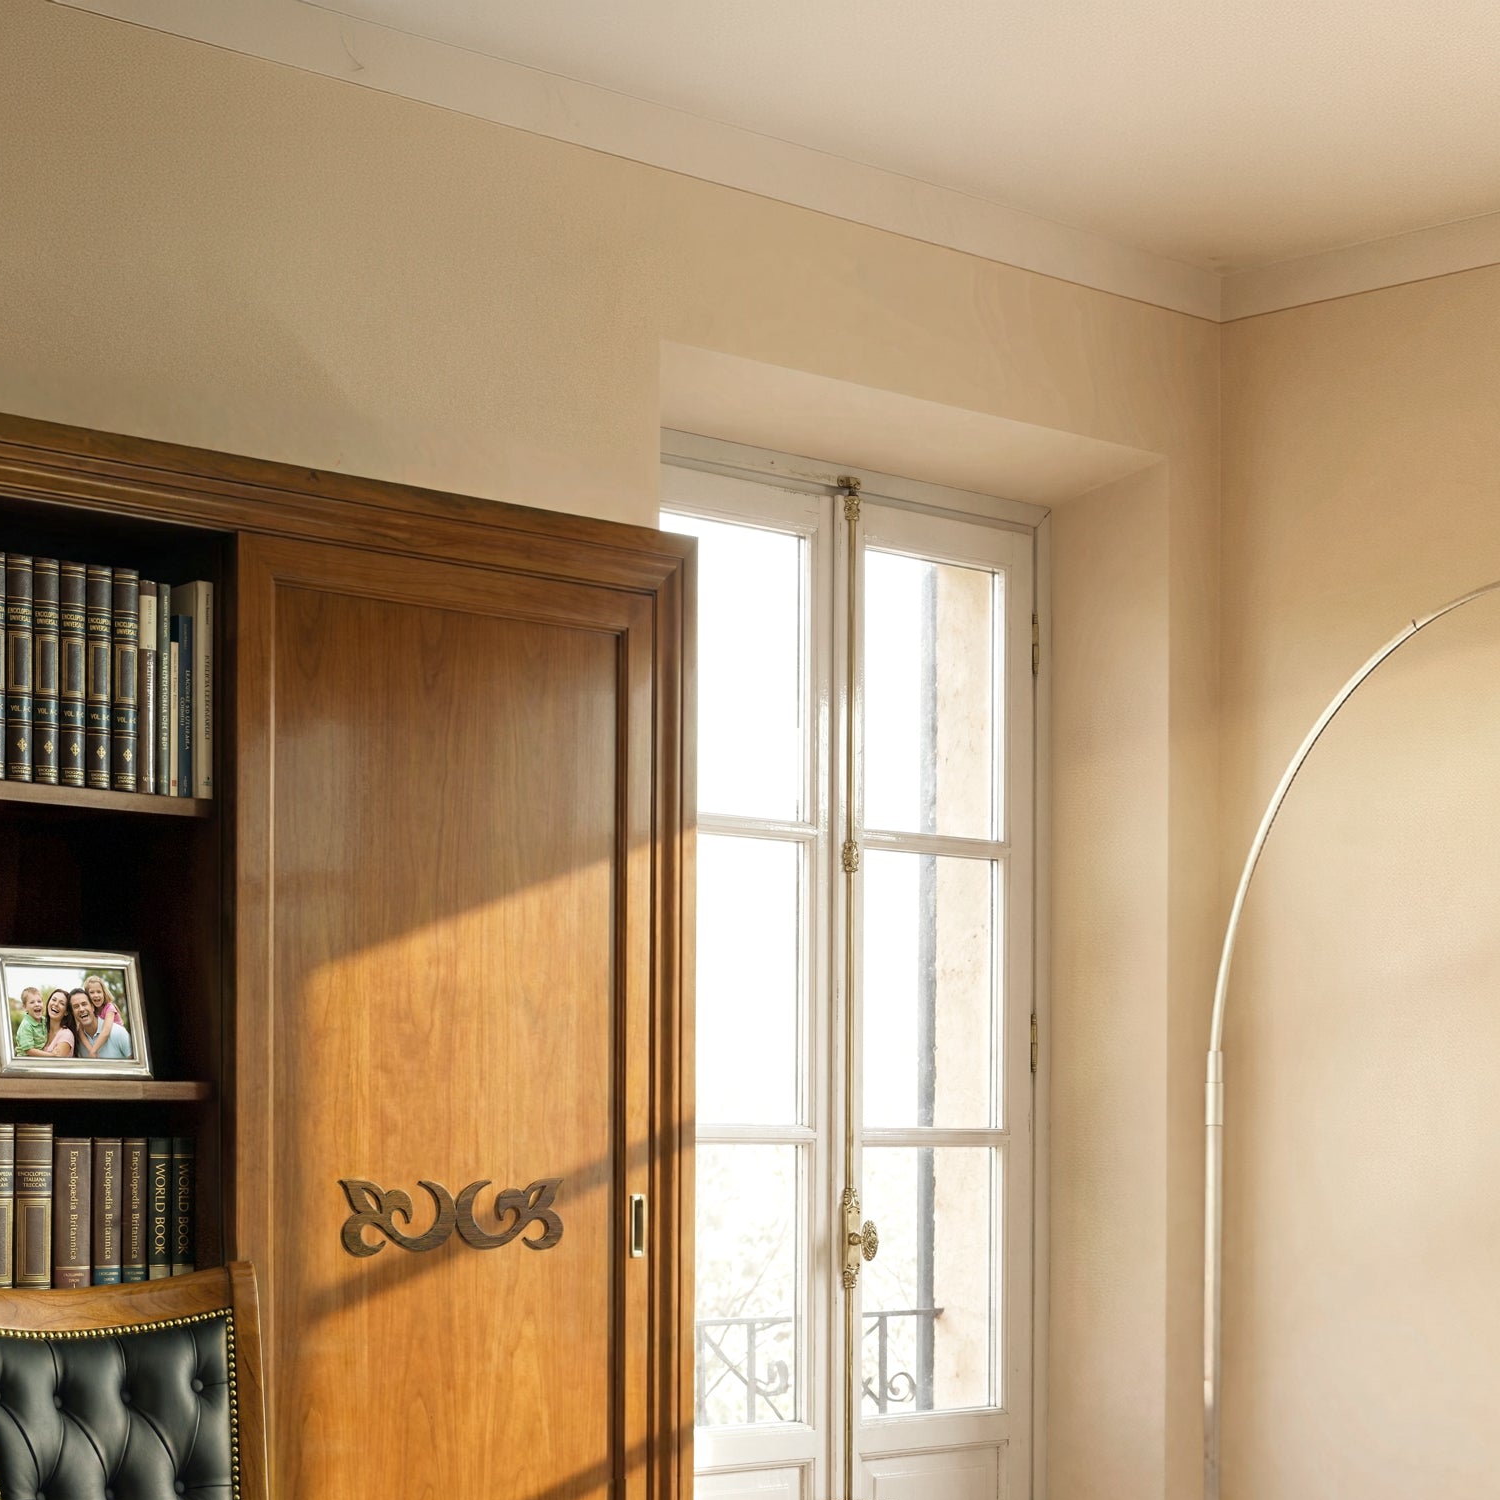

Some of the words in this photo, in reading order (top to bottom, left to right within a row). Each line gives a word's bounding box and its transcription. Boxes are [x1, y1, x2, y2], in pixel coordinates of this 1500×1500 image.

[154, 1163, 166, 1213] WORLD
[178, 1163, 190, 1212] WORLD
[69, 1214, 78, 1261] Britannica
[104, 1213, 113, 1260] Britannica
[131, 1213, 140, 1259] Britannica
[154, 1217, 166, 1255] BOOK
[178, 1216, 189, 1255] BOOK
